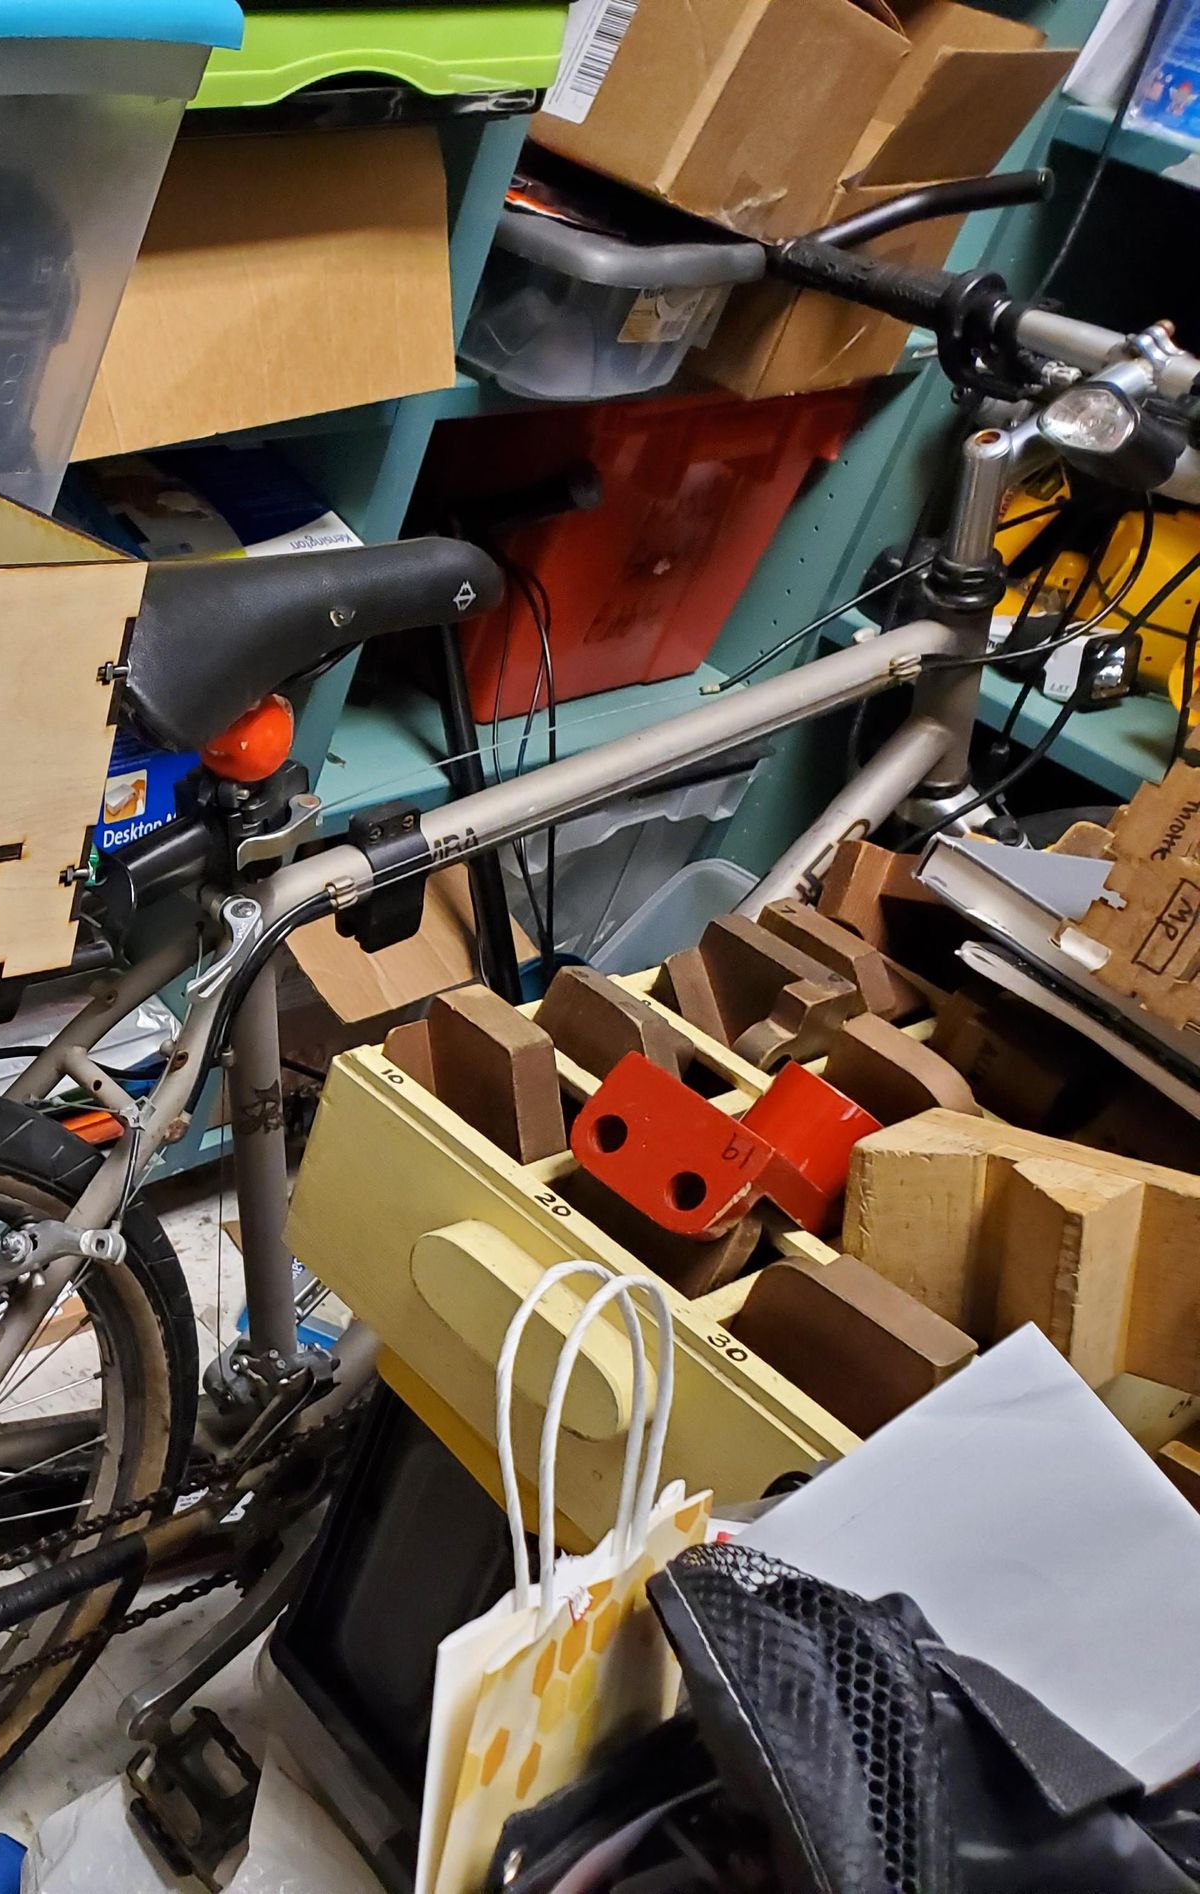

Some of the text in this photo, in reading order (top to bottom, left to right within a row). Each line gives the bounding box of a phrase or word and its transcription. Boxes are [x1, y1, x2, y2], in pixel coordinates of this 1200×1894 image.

[289, 533, 353, 550] Kensington
[380, 1068, 405, 1085] 10
[533, 1192, 572, 1217] 20
[706, 1333, 748, 1362] 30
